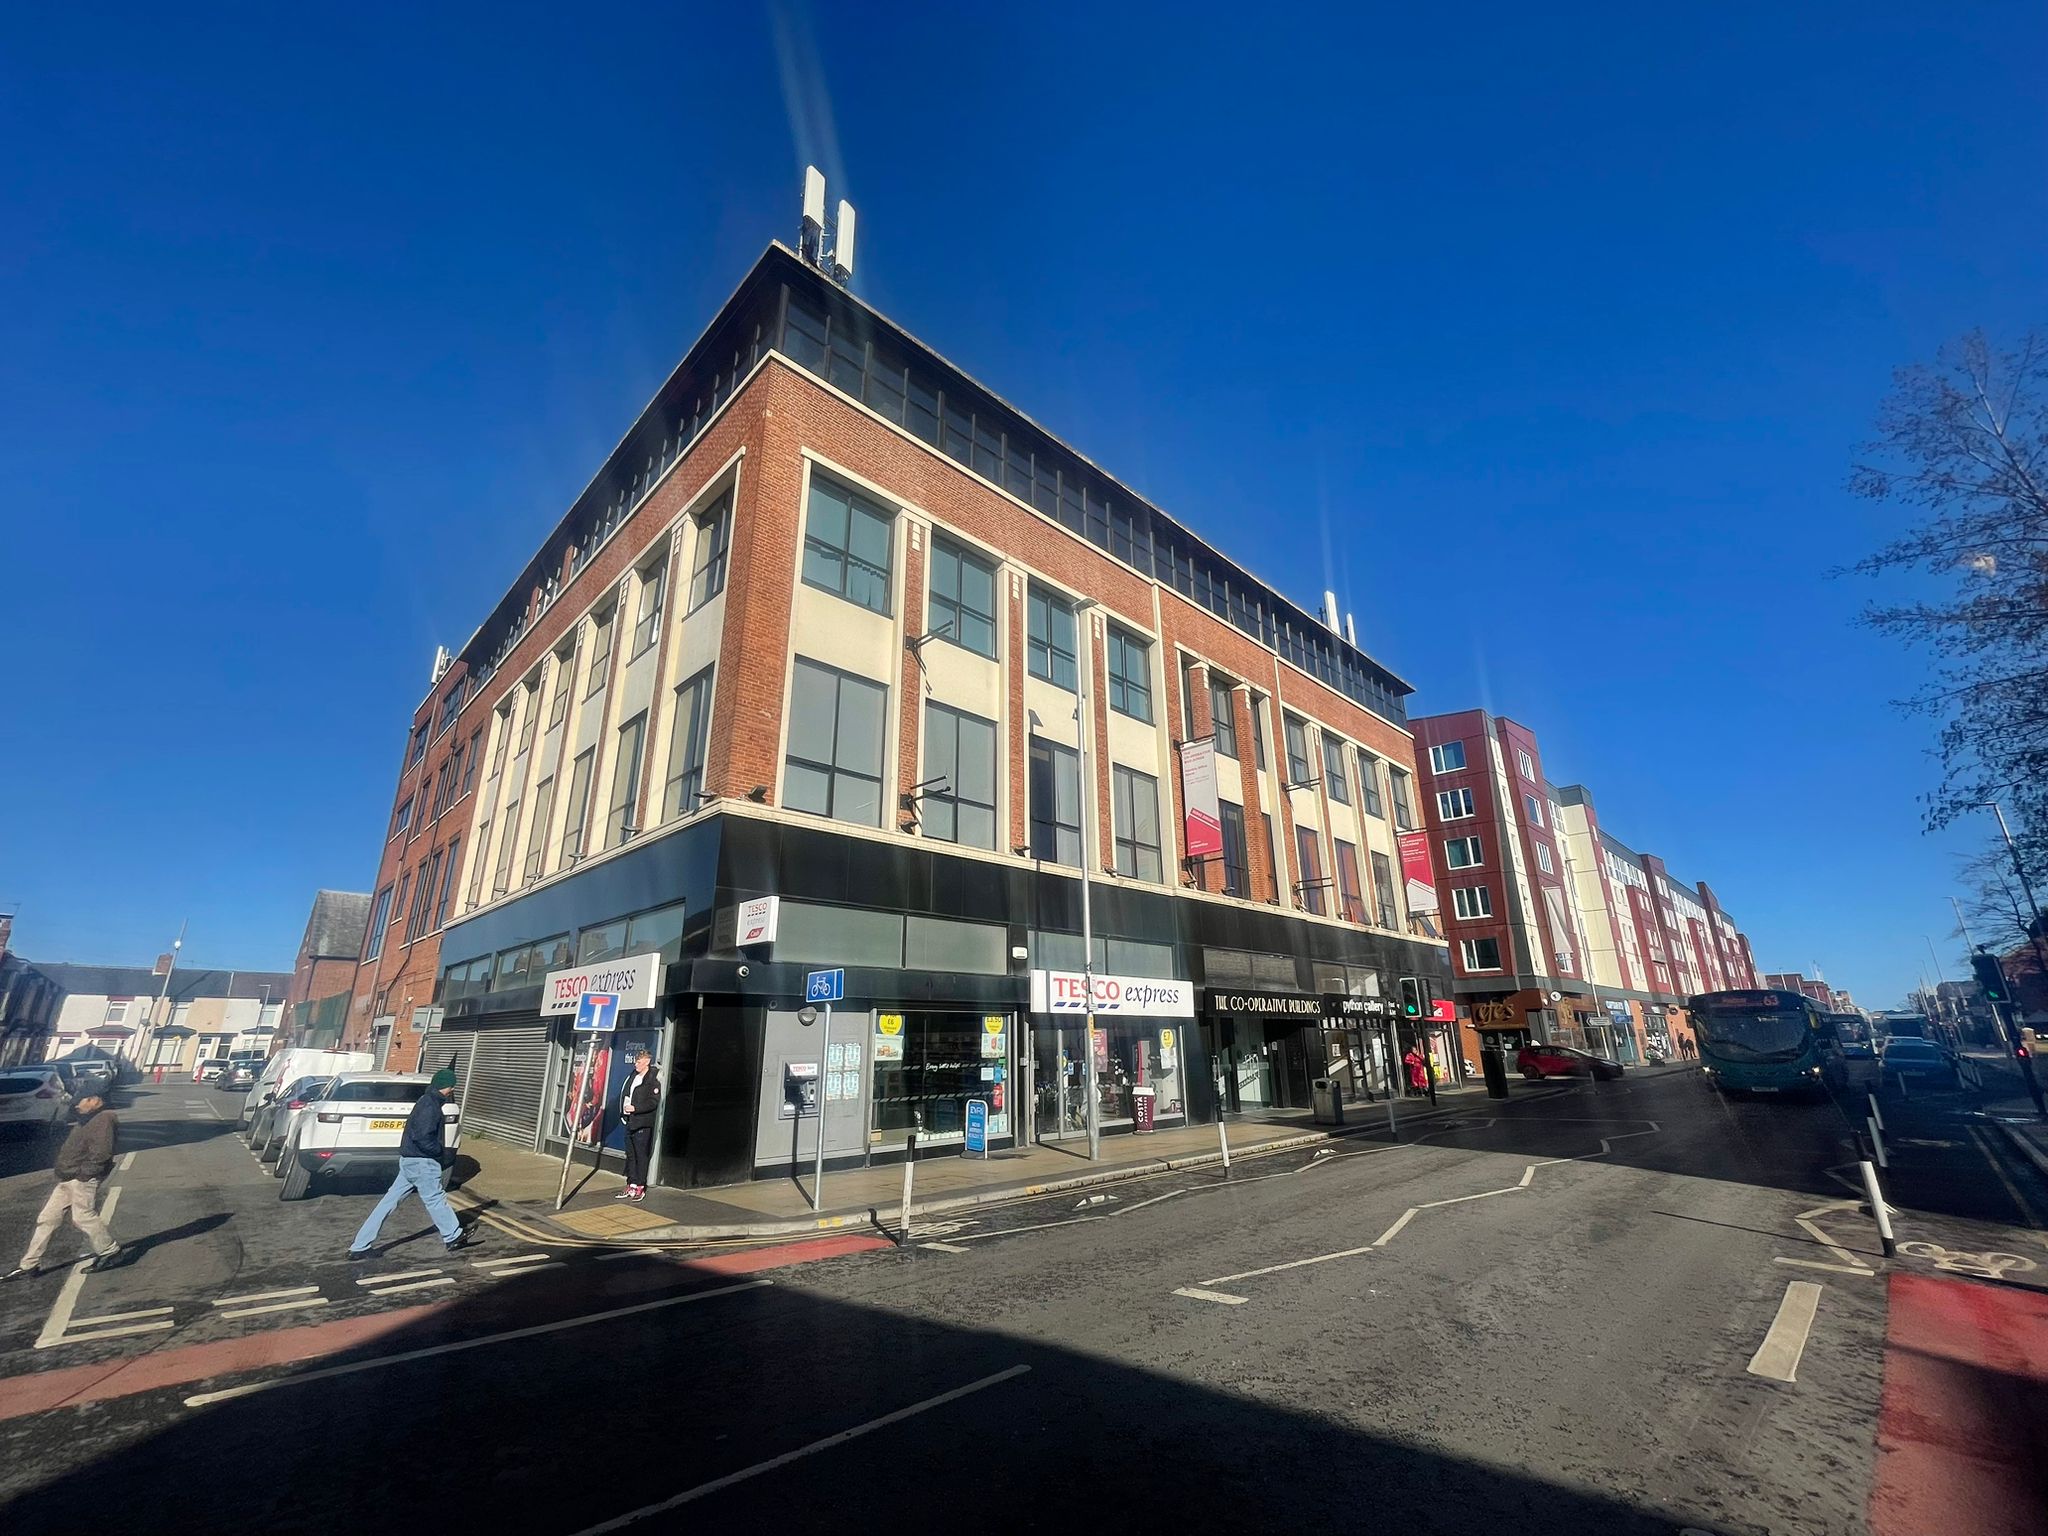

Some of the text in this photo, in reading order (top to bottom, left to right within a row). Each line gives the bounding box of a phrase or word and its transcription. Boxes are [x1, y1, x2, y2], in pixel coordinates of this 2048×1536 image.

[748, 902, 768, 913] TESCO
[554, 967, 637, 1000] TESCO express
[1052, 977, 1180, 1009] TESCO express
[1763, 994, 1779, 1006] 63
[1214, 995, 1321, 1014] THE CO-OPERATIVE BUILDINGS
[1342, 999, 1364, 1014] python
[1363, 1000, 1384, 1015] gallery
